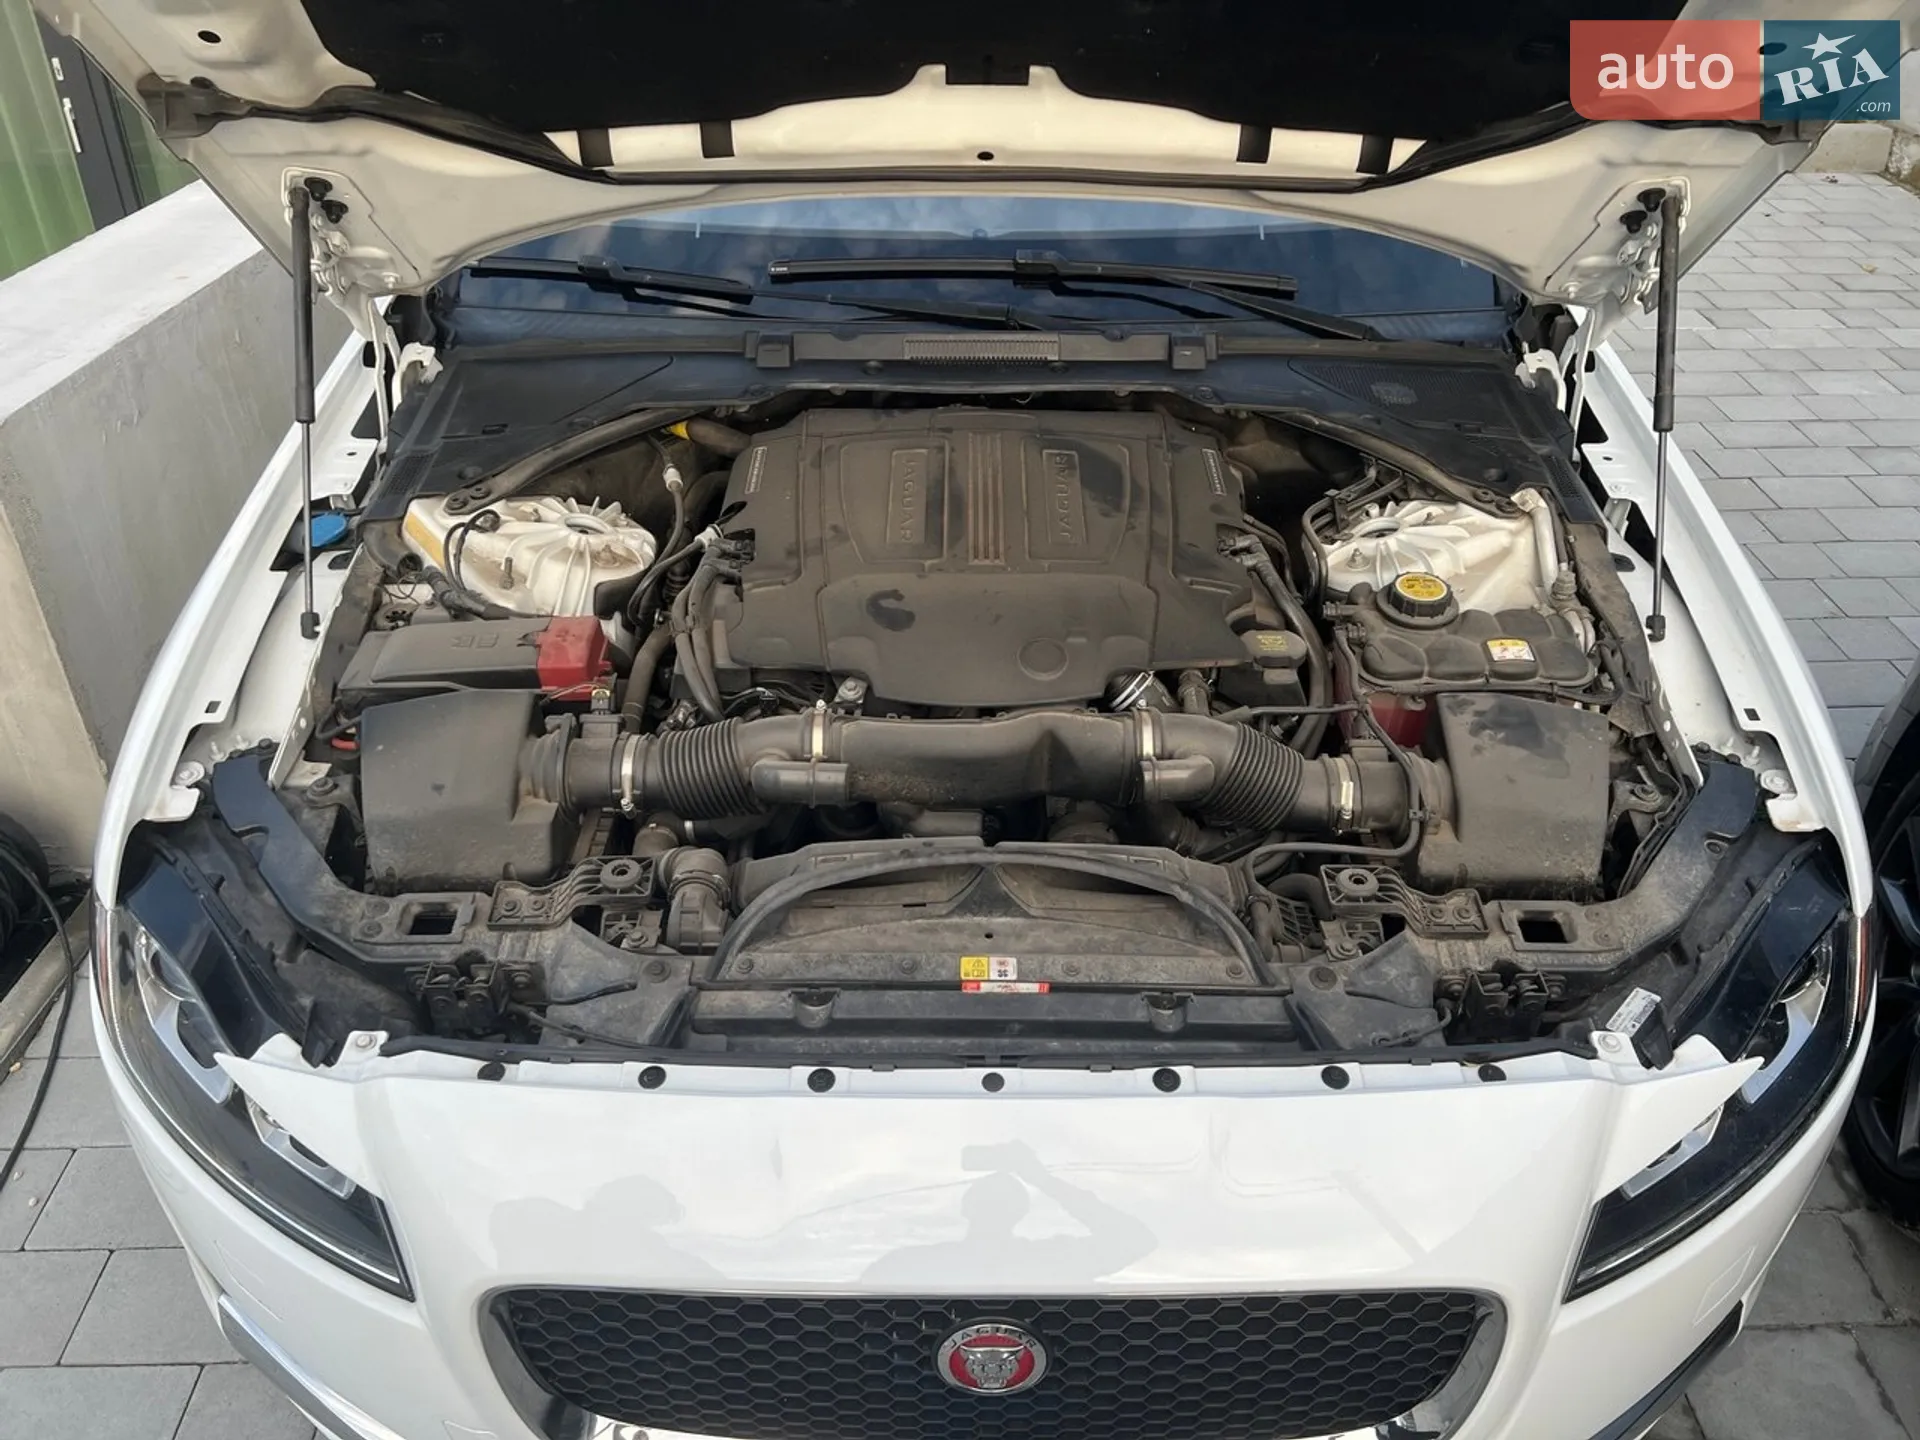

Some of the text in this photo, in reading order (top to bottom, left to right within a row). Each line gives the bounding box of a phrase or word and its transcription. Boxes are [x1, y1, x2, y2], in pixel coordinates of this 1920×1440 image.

[901, 459, 917, 543] JAGUAR
[1054, 454, 1076, 542] JAGUAR
[950, 1326, 1037, 1349] JAGUAR
